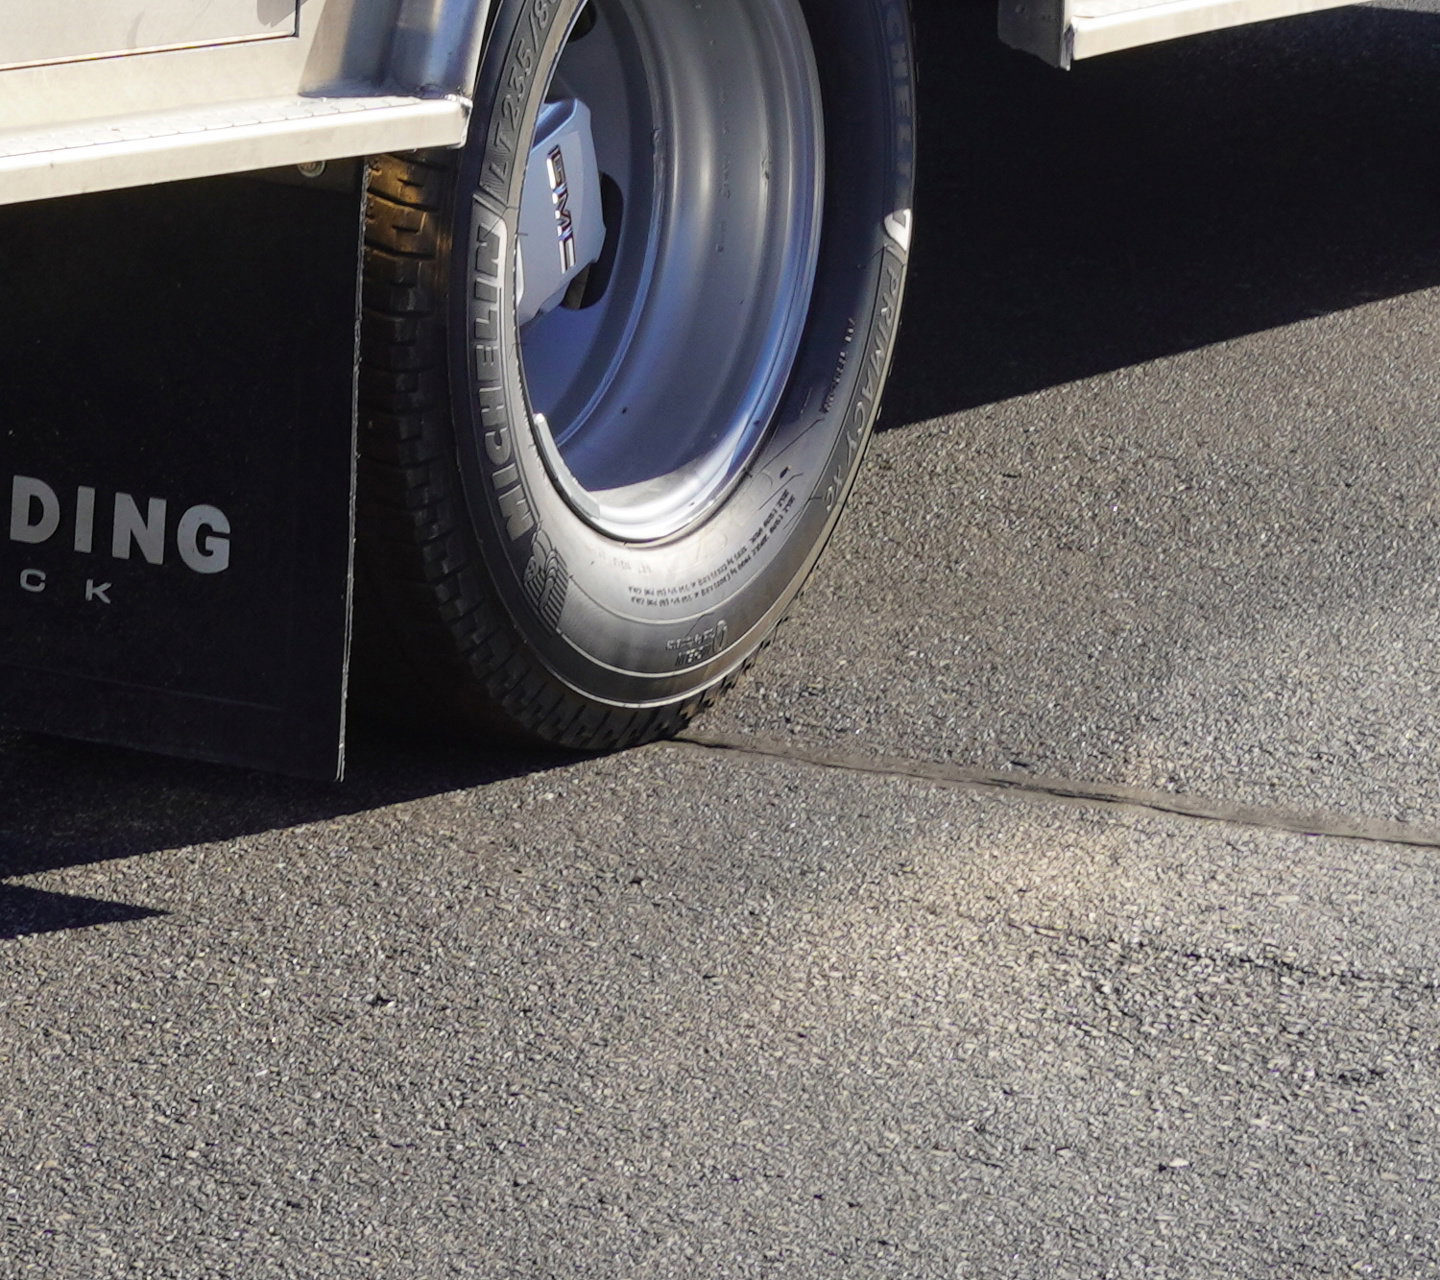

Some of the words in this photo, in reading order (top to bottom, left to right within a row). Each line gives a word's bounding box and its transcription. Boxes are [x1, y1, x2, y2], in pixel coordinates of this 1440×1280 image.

[546, 144, 577, 275] GMC
[473, 222, 537, 542] MICHELIN
[845, 263, 901, 468] PRIMACY
